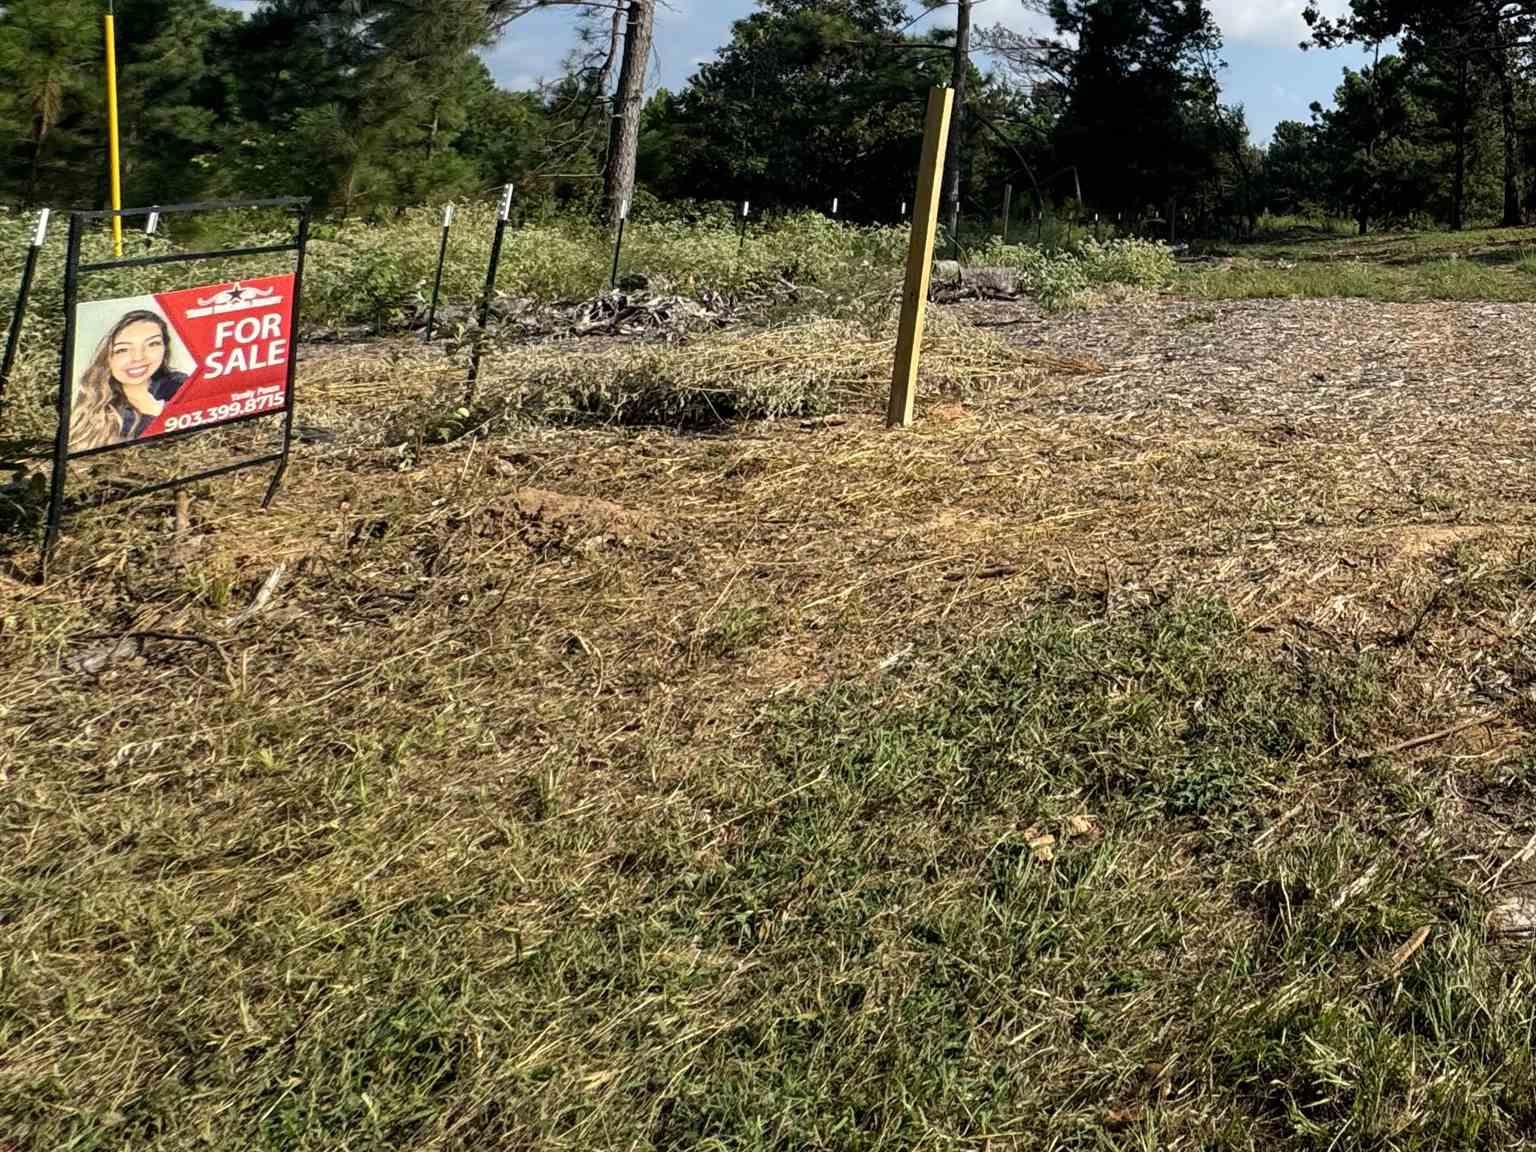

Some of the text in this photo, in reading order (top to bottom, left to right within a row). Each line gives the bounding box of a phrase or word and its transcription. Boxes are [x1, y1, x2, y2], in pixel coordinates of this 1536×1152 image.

[215, 313, 282, 349] FOR
[203, 339, 286, 380] SALE
[164, 391, 285, 433] 903.399.8715
